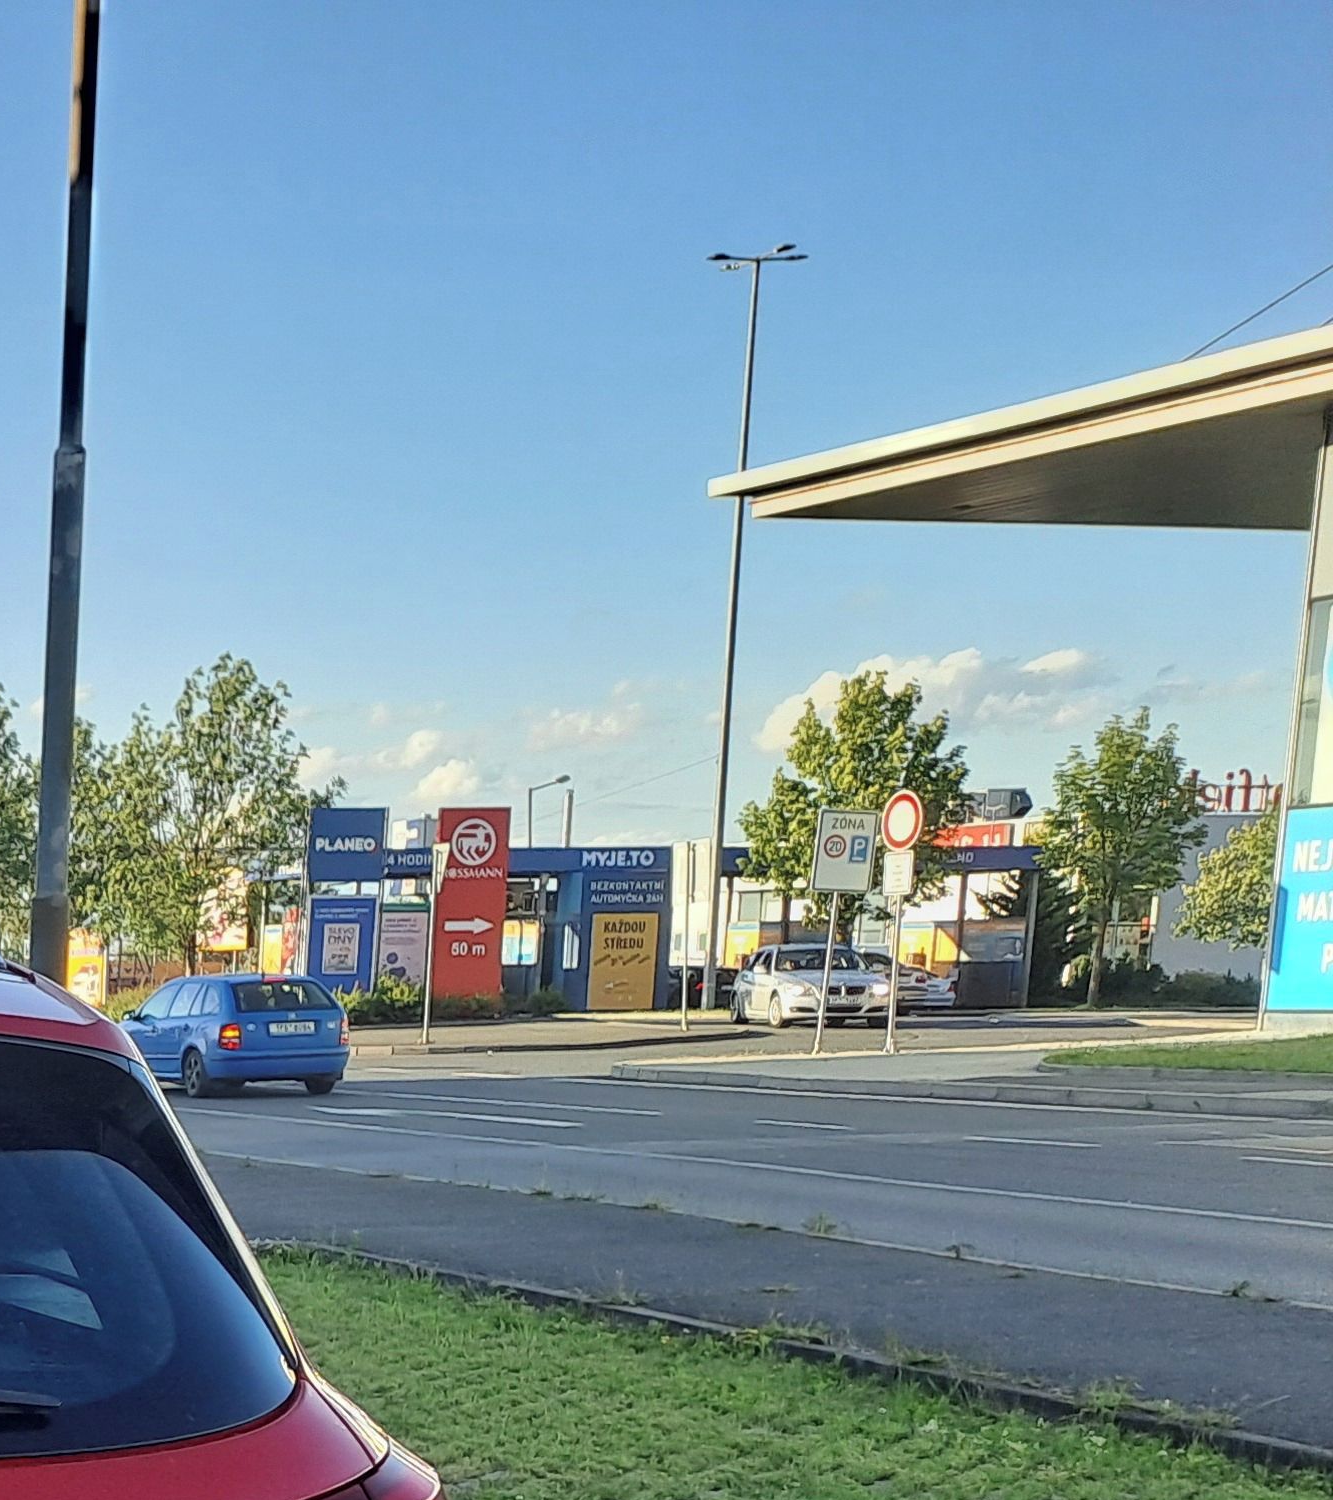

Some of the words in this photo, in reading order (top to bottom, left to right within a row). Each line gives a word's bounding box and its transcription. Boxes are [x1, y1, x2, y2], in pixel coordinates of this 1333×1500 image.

[831, 816, 865, 830] ZÓNA
[315, 837, 376, 852] PLANEO
[828, 840, 842, 852] 20
[581, 850, 655, 867] MYJE.TO
[603, 918, 646, 933] KAŽDOU
[472, 943, 486, 956] m
[604, 936, 644, 950] STŘEDU
